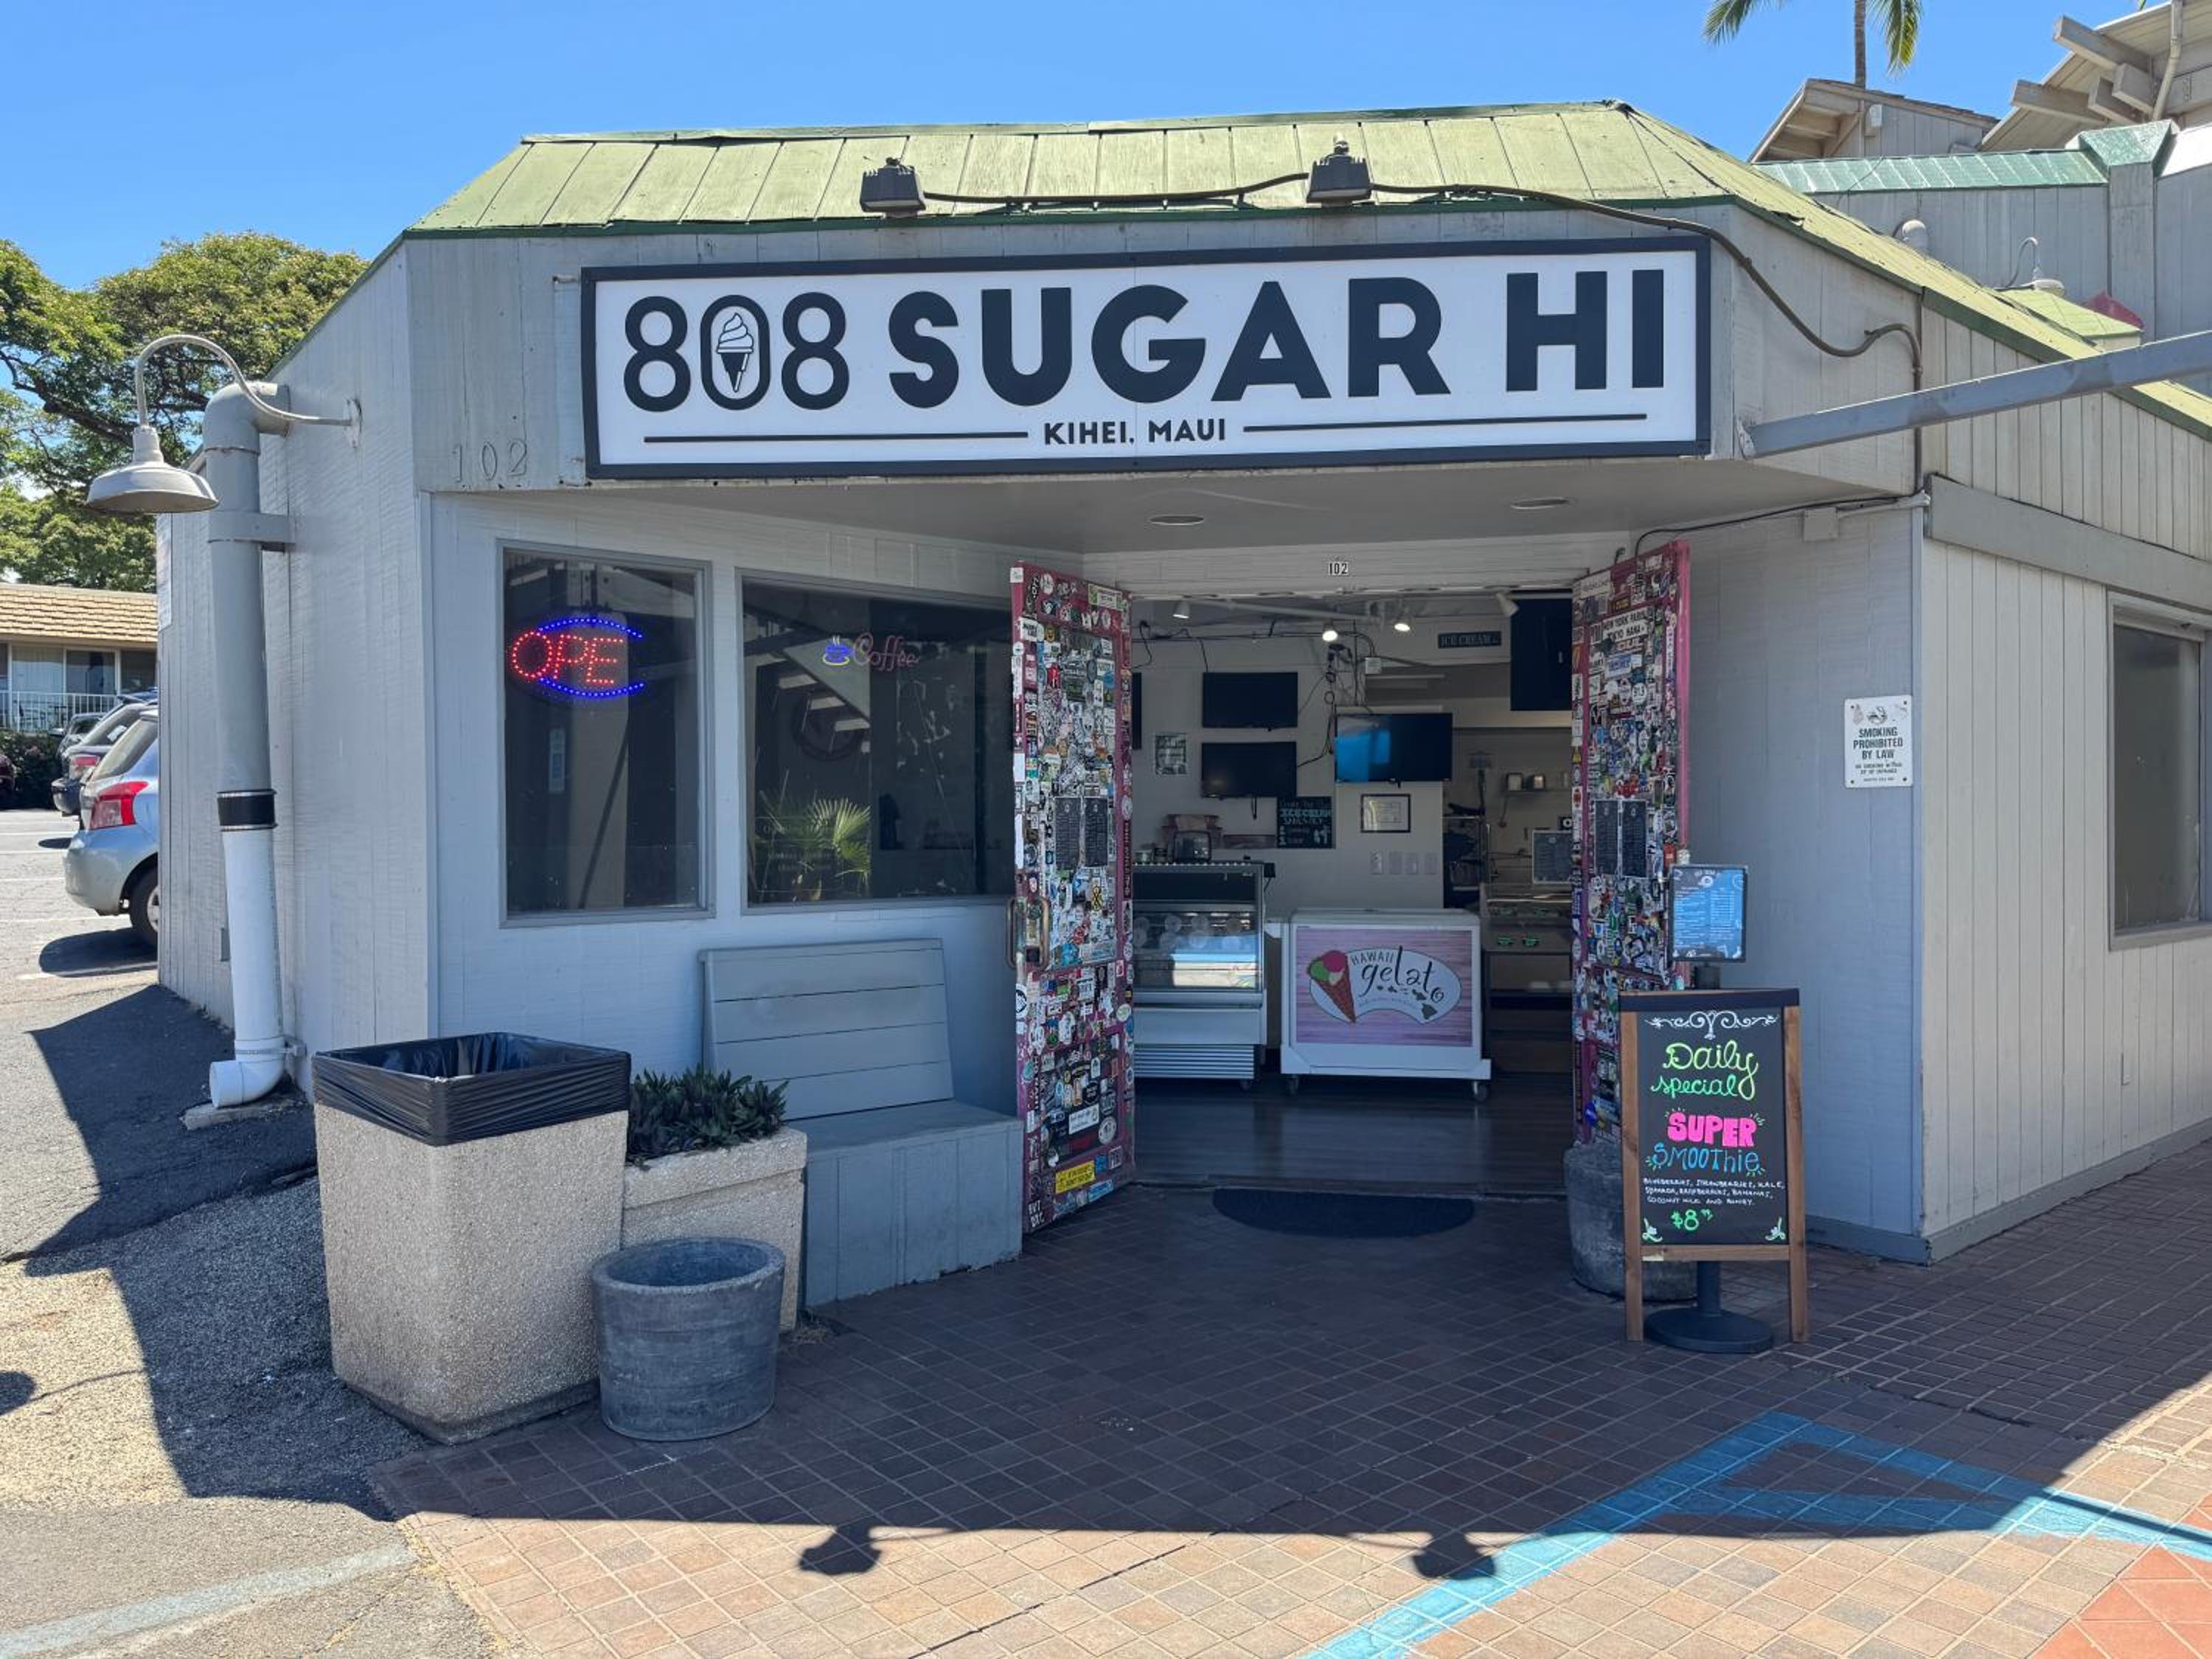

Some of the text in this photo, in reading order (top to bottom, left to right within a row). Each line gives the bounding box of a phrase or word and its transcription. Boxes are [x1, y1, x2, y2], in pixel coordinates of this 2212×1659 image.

[623, 269, 1664, 412] 808 SUGAR HI
[1148, 418, 1225, 442] MAUI
[451, 438, 528, 483] 102
[1329, 562, 1348, 574] 102
[852, 632, 919, 672] Coffee
[1853, 737, 1903, 749] PROHIBITED
[1859, 727, 1898, 737] SMOKING
[1862, 750, 1895, 759] BY LAW
[1350, 950, 1395, 966] HAWAII
[1358, 945, 1445, 1004] gelato
[1662, 1040, 1759, 1100] Daily
[1650, 1074, 1739, 1099] special
[1667, 1112, 1758, 1148] SUPER
